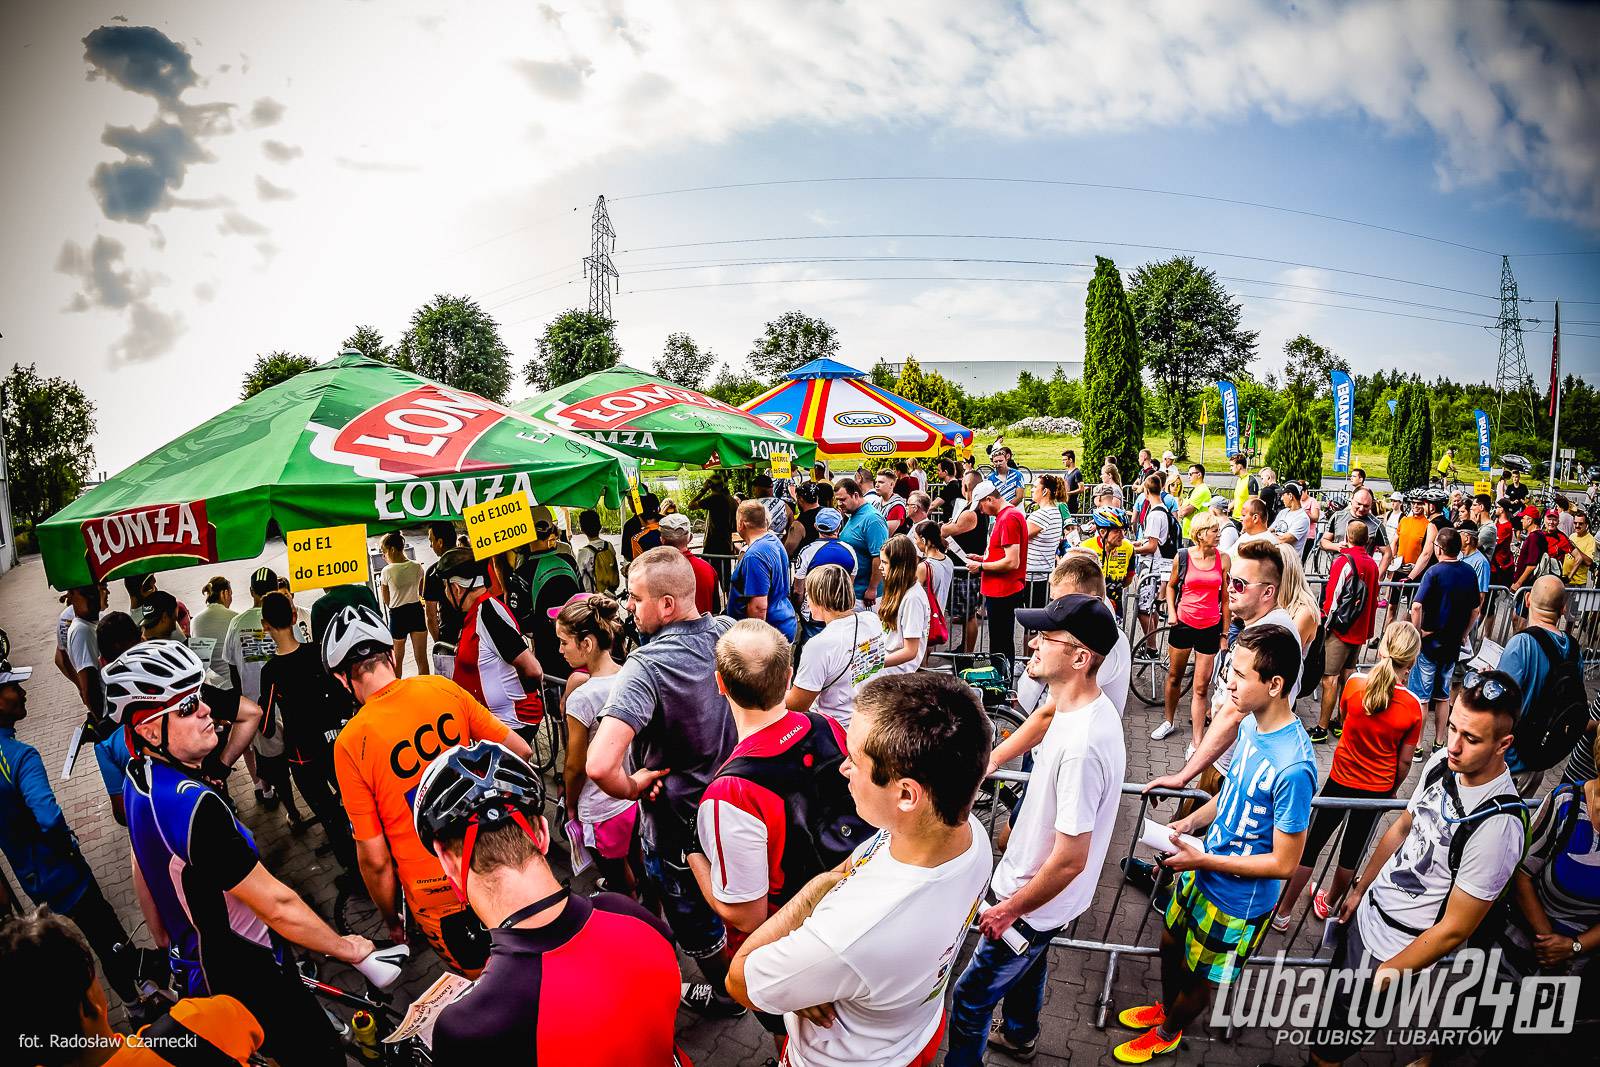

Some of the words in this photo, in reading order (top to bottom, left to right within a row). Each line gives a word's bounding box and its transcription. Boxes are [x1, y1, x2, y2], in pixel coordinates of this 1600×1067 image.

[844, 414, 887, 425] koral
[868, 441, 891, 452] koral
[470, 510, 486, 525] od
[487, 500, 523, 520] E1001
[86, 503, 200, 564] ŁOMŻA
[293, 537, 311, 552] od
[316, 536, 332, 550] E1
[476, 536, 492, 549] do
[493, 523, 528, 543] E2000
[294, 566, 313, 580] do
[317, 560, 358, 577] E1000
[779, 724, 803, 745] ARSENAL
[390, 713, 461, 779] CCC
